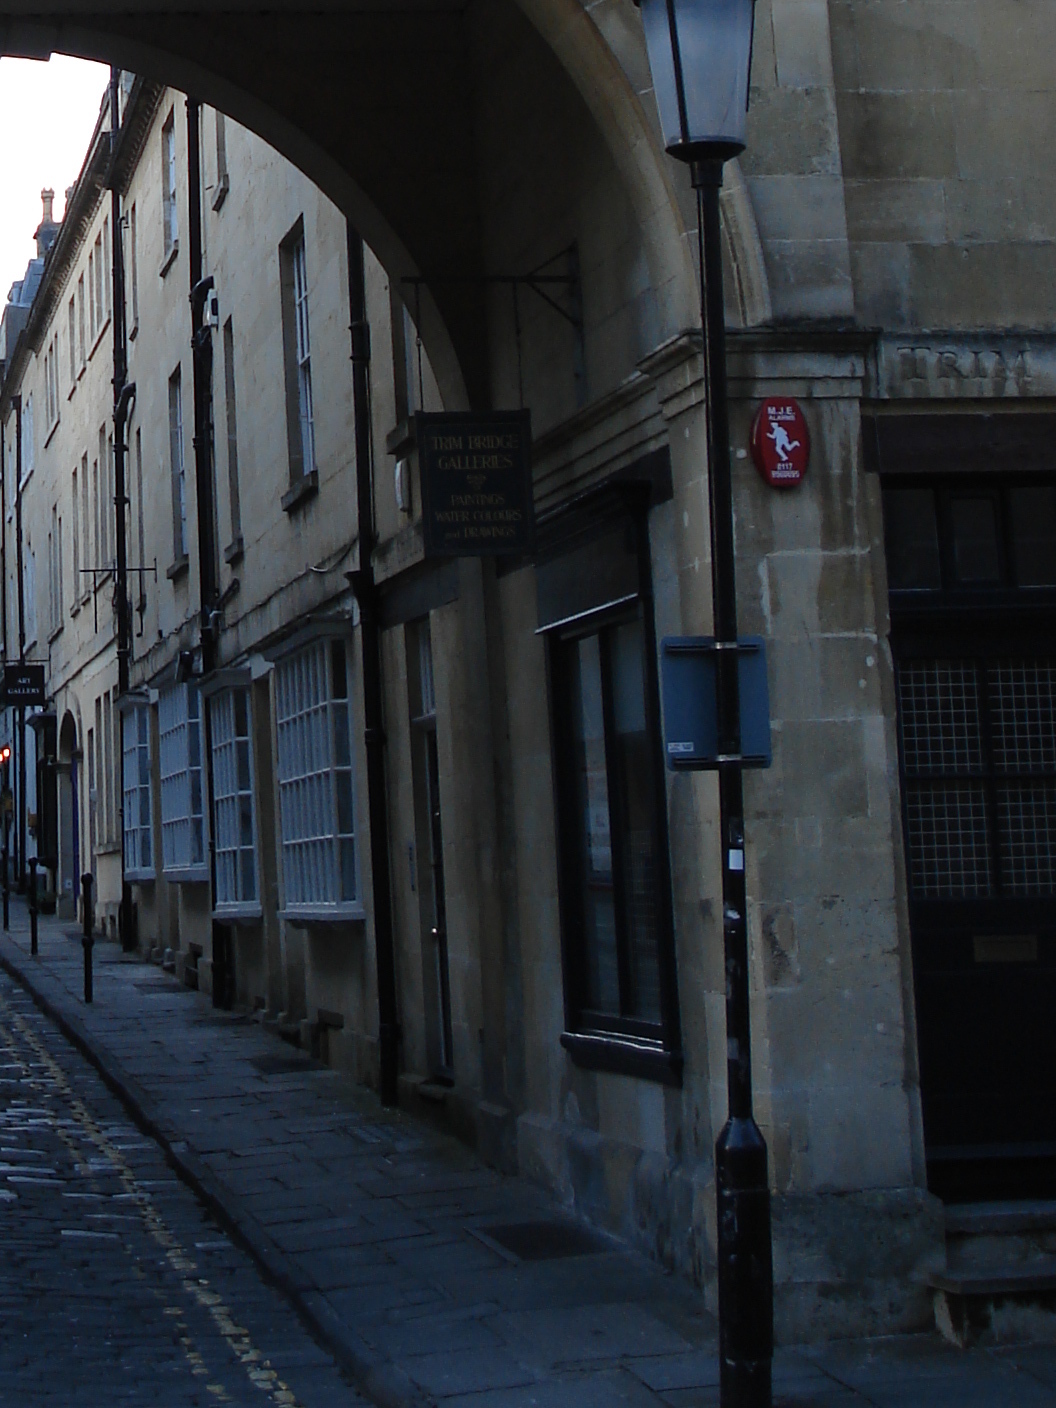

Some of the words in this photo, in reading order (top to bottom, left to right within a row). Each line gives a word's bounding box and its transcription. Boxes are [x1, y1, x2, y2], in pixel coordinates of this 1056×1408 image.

[895, 346, 1032, 380] TRIM
[432, 436, 463, 450] TRIM
[468, 434, 519, 450] BRIDGE
[437, 454, 513, 470] GALLERIES
[450, 494, 505, 506] PAINTINGS
[434, 511, 469, 522] WATER
[473, 509, 522, 521] COLOURS
[464, 526, 516, 538] DRAWINGS
